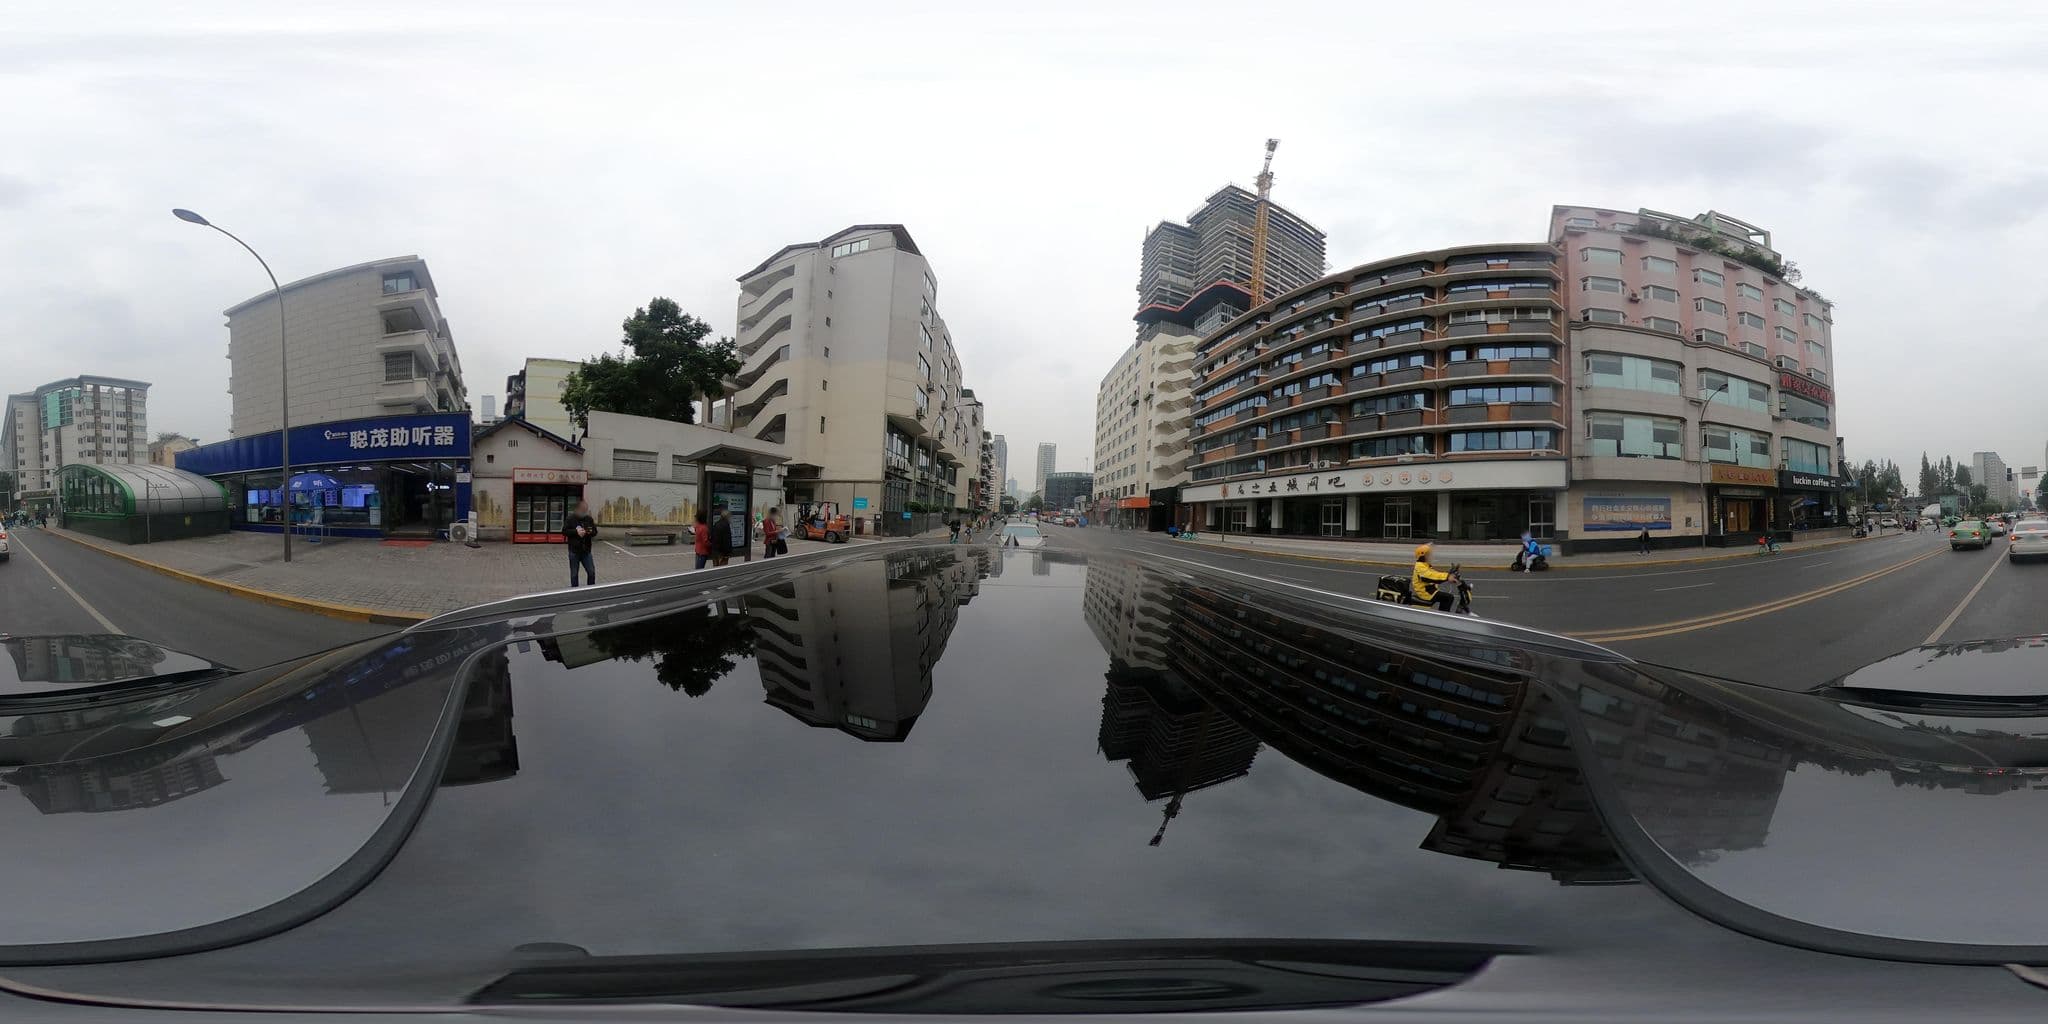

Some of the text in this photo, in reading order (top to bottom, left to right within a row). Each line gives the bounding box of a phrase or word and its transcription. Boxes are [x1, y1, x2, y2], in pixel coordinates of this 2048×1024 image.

[349, 426, 455, 449] 聪茂助听器
[1793, 475, 1811, 486] luckin
[1812, 478, 1829, 487] coffee
